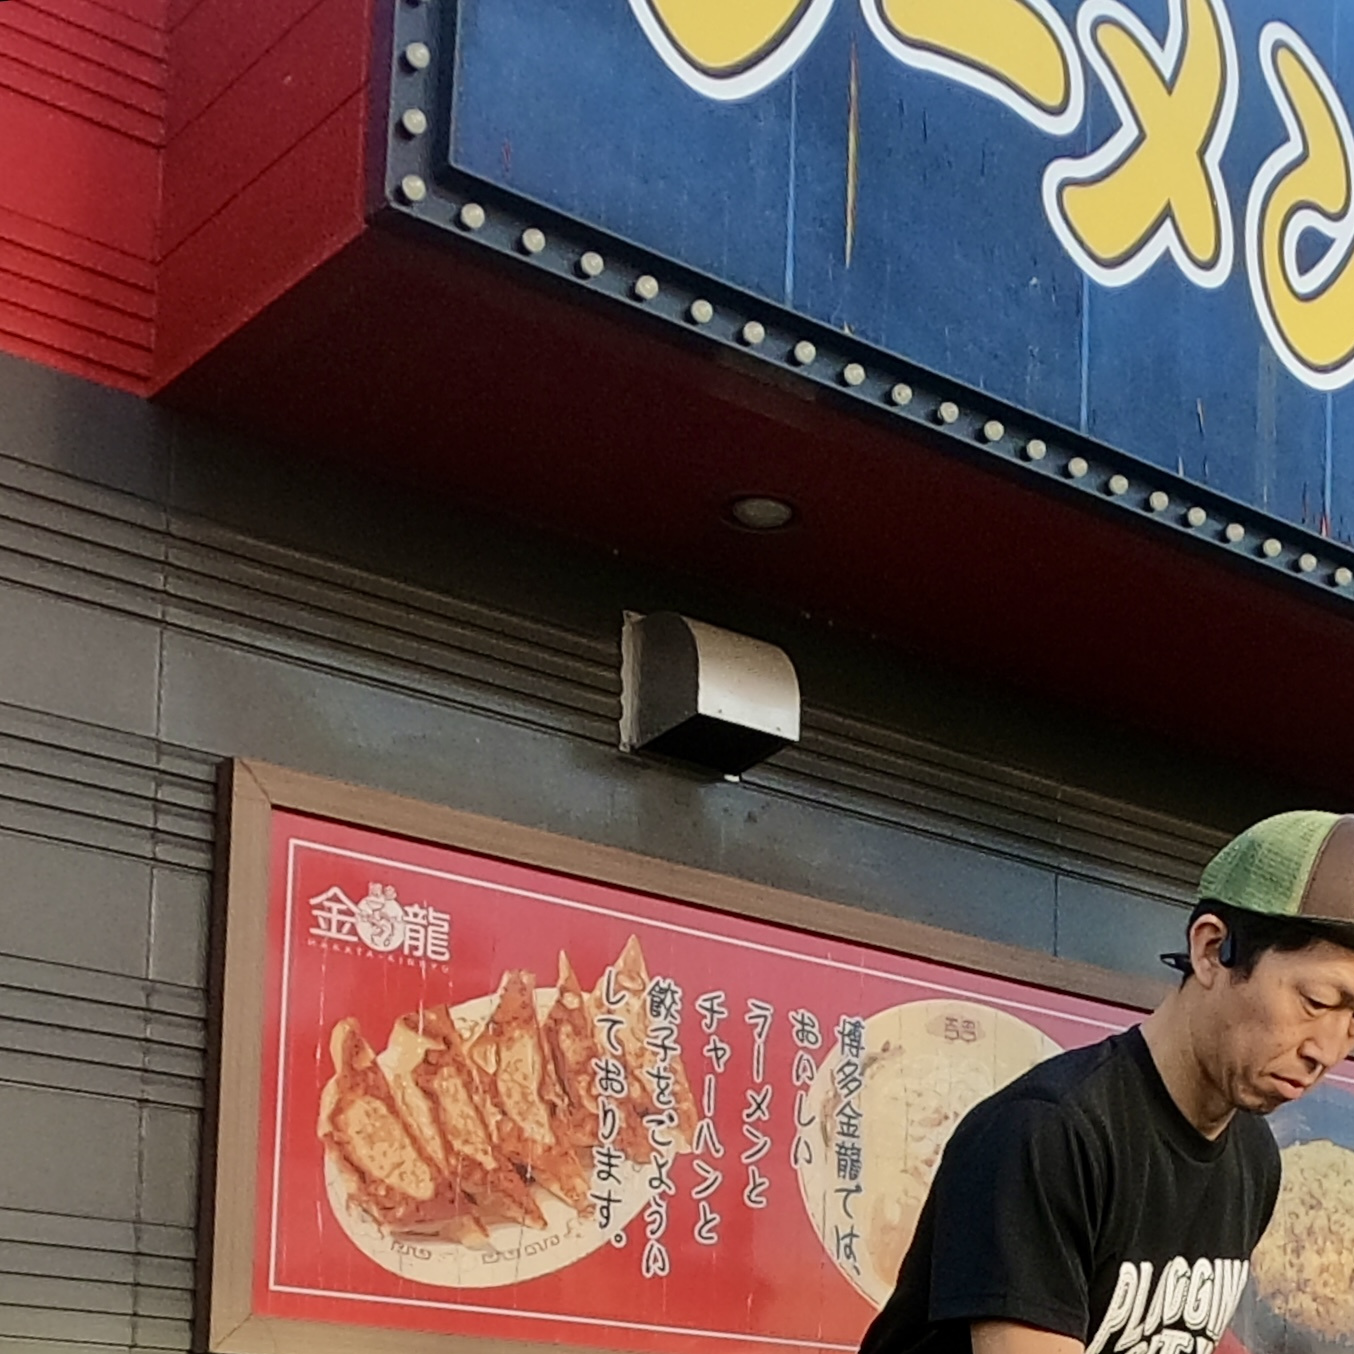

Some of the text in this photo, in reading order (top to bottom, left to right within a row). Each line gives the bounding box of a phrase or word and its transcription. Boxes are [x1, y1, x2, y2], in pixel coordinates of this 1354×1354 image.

[309, 886, 451, 961] 金龍
[590, 969, 626, 1246] しております。
[645, 977, 680, 1277] 餃子をごようい
[694, 994, 730, 1242] チャーハンと
[740, 999, 772, 1207] ラーメンと
[790, 1009, 821, 1167] おいしい
[834, 1016, 865, 1276] 博多金龍では、
